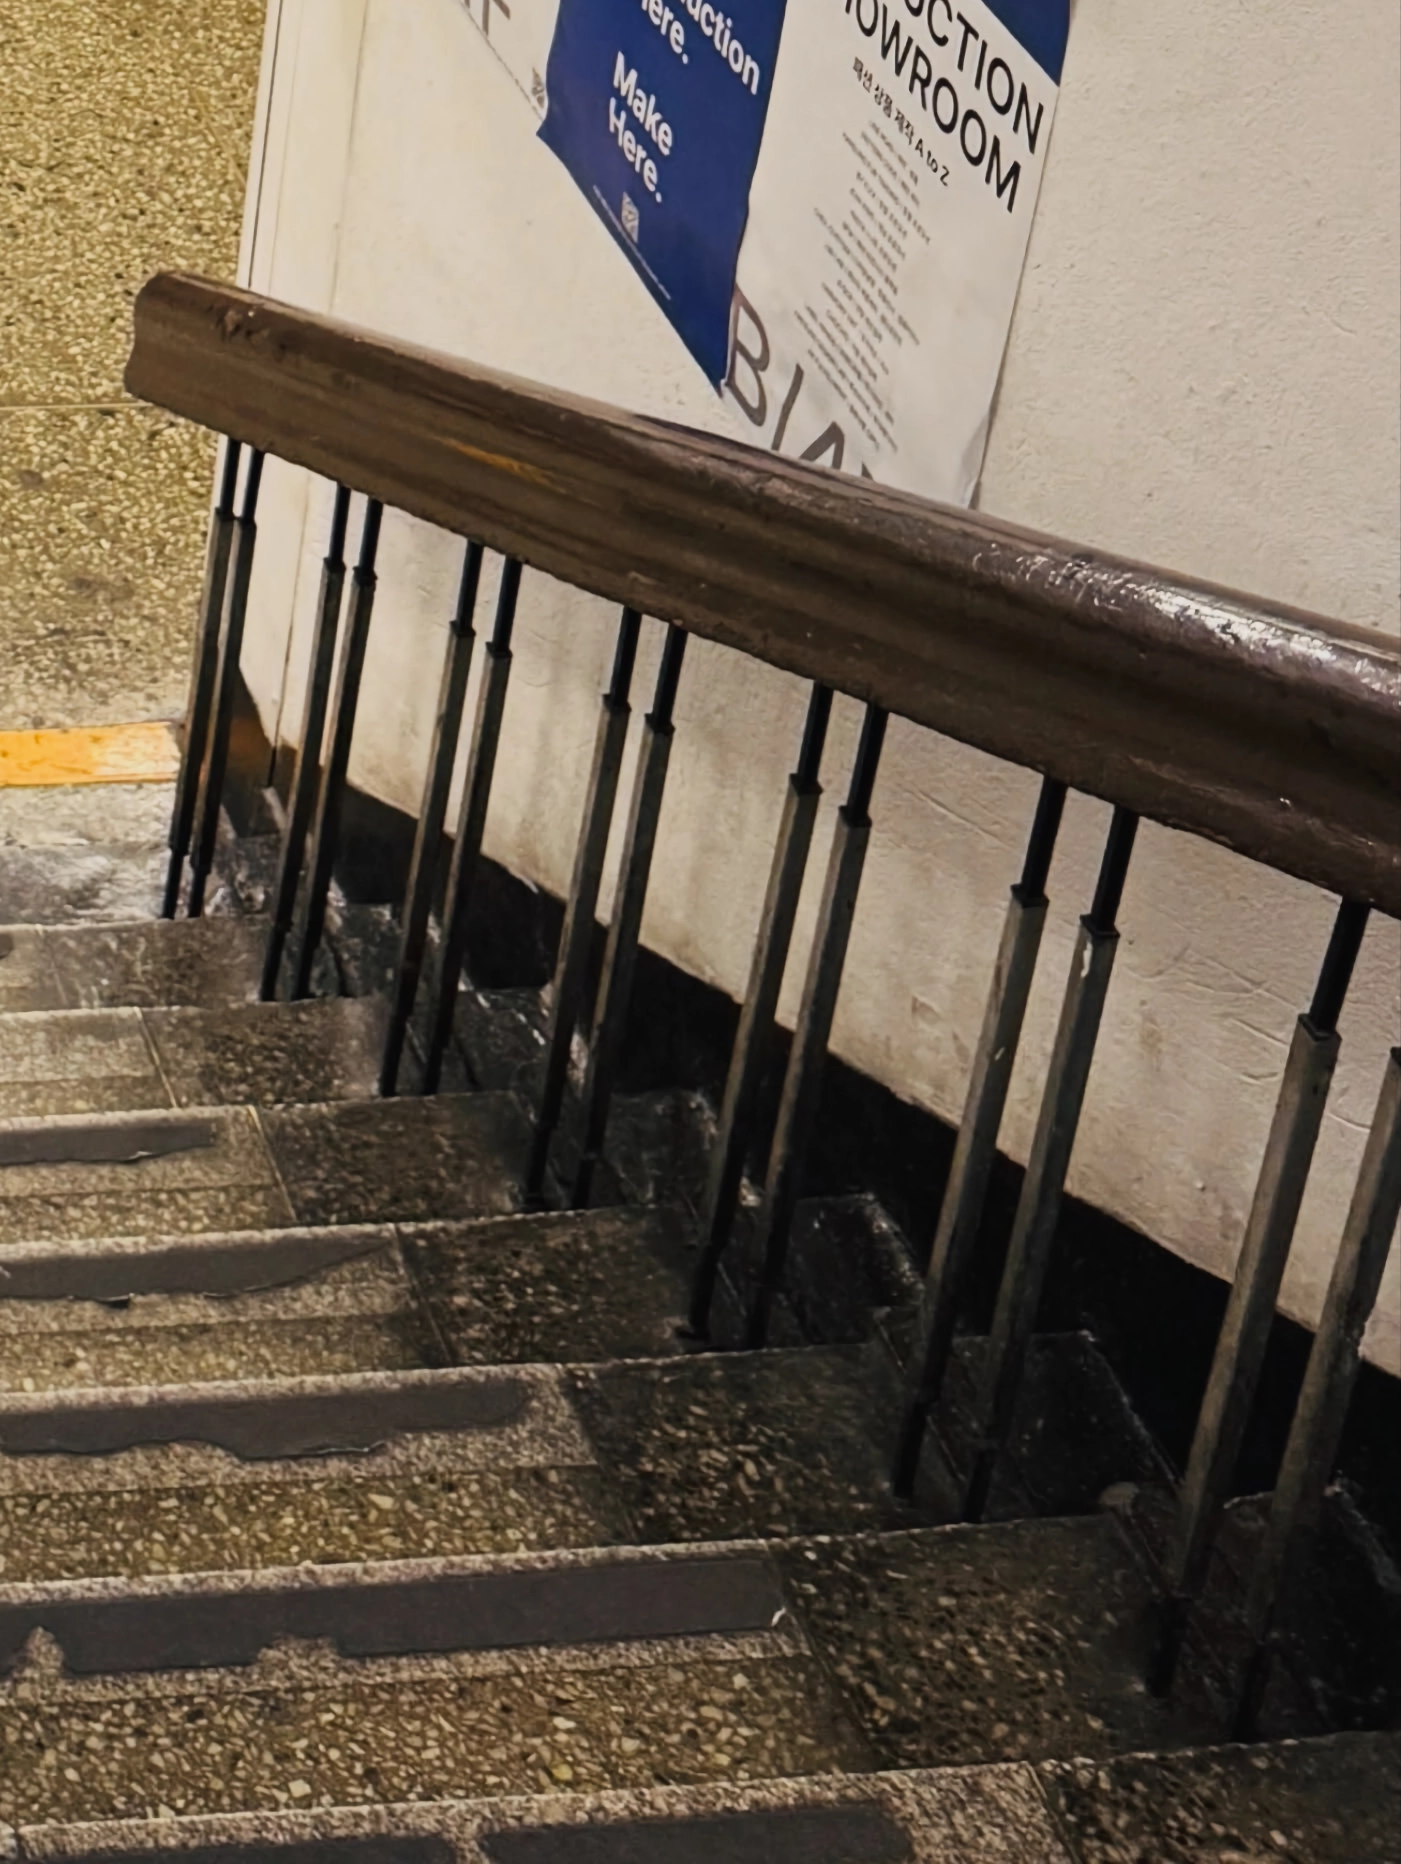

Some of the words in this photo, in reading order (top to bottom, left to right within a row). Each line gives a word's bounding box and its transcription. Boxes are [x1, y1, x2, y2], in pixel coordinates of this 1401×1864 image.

[609, 97, 662, 203] Here.
[613, 51, 673, 156] Make
[915, 138, 923, 157] A
[940, 165, 949, 186] Z
